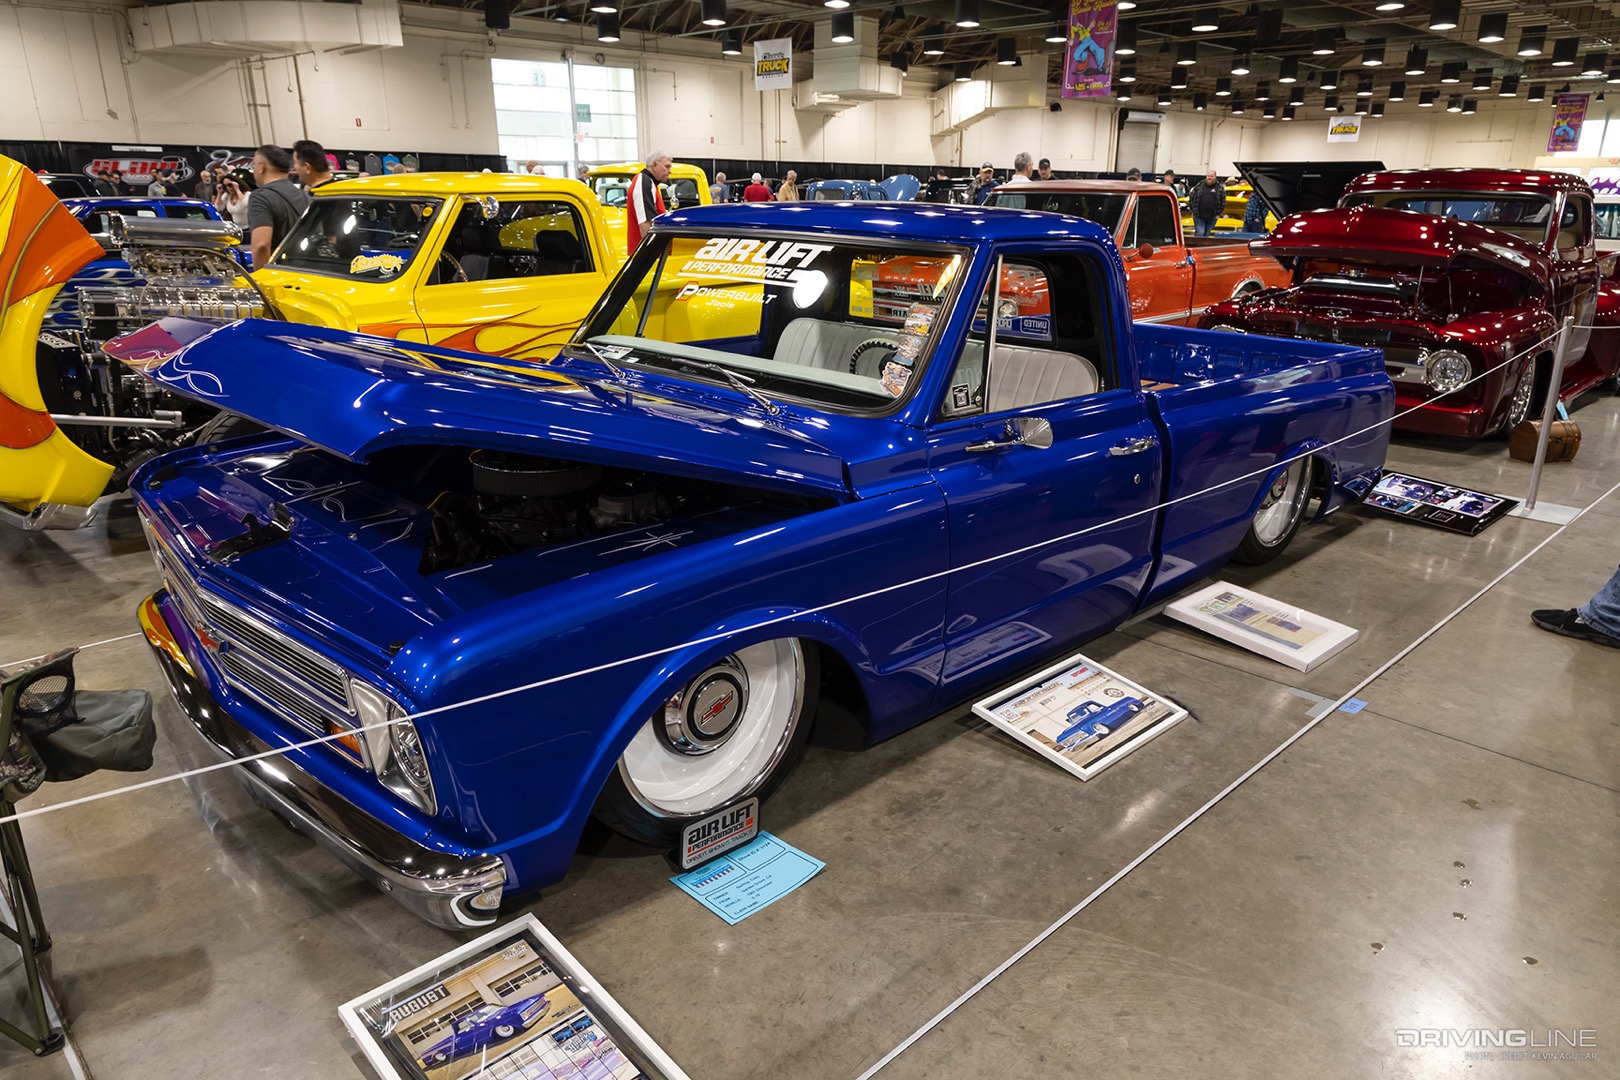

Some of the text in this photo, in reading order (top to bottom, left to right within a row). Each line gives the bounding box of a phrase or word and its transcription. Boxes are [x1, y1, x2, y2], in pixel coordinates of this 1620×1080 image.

[757, 58, 789, 75] TRUCK
[1330, 126, 1357, 135] TRUCK
[751, 240, 835, 268] LIFT
[690, 261, 793, 280] PERFORMANCE
[675, 283, 778, 305] POWERBUILT
[705, 299, 735, 309] Tools
[721, 803, 755, 830] LIFT
[692, 820, 746, 851] PERFORMANCE
[389, 985, 447, 1022] AUGUST
